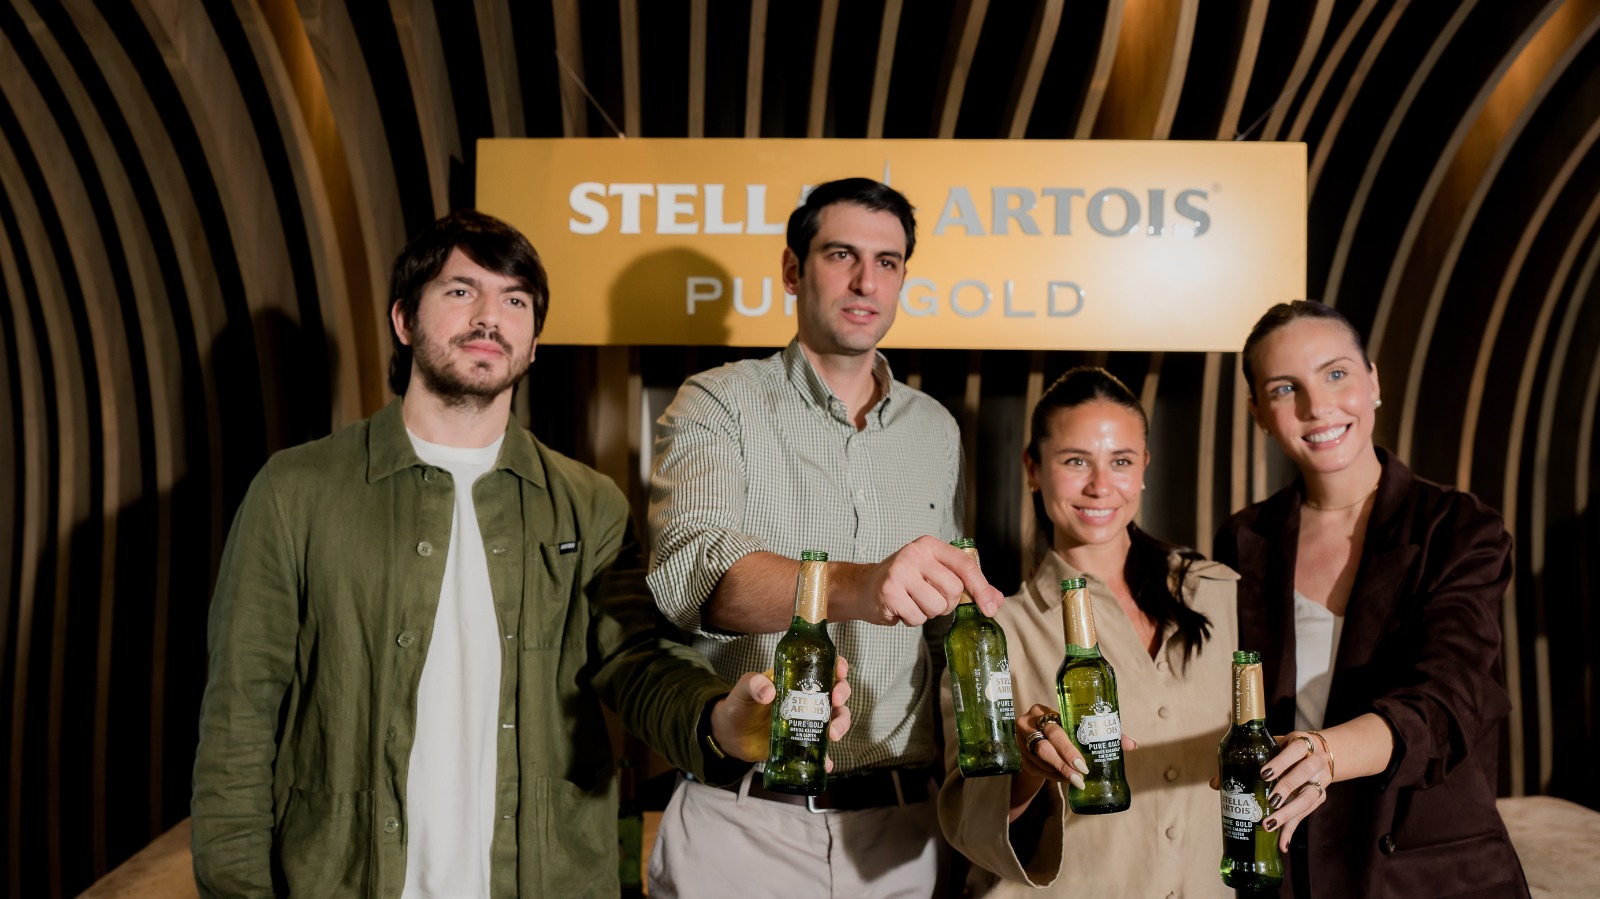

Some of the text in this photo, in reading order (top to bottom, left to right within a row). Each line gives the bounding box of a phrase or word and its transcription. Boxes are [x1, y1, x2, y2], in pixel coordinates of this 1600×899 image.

[568, 182, 1211, 238] STELL ARTOIS
[686, 276, 1086, 318] PU GOLD
[792, 696, 824, 706] STELLA
[791, 705, 824, 714] ARTOIS
[788, 720, 806, 728] PURE
[1087, 719, 1116, 728] STLLA
[1089, 726, 1117, 736] AOIS
[1089, 740, 1120, 750] PURE GOLD
[1222, 796, 1249, 806] STELLA
[1235, 820, 1252, 828] GOLD
